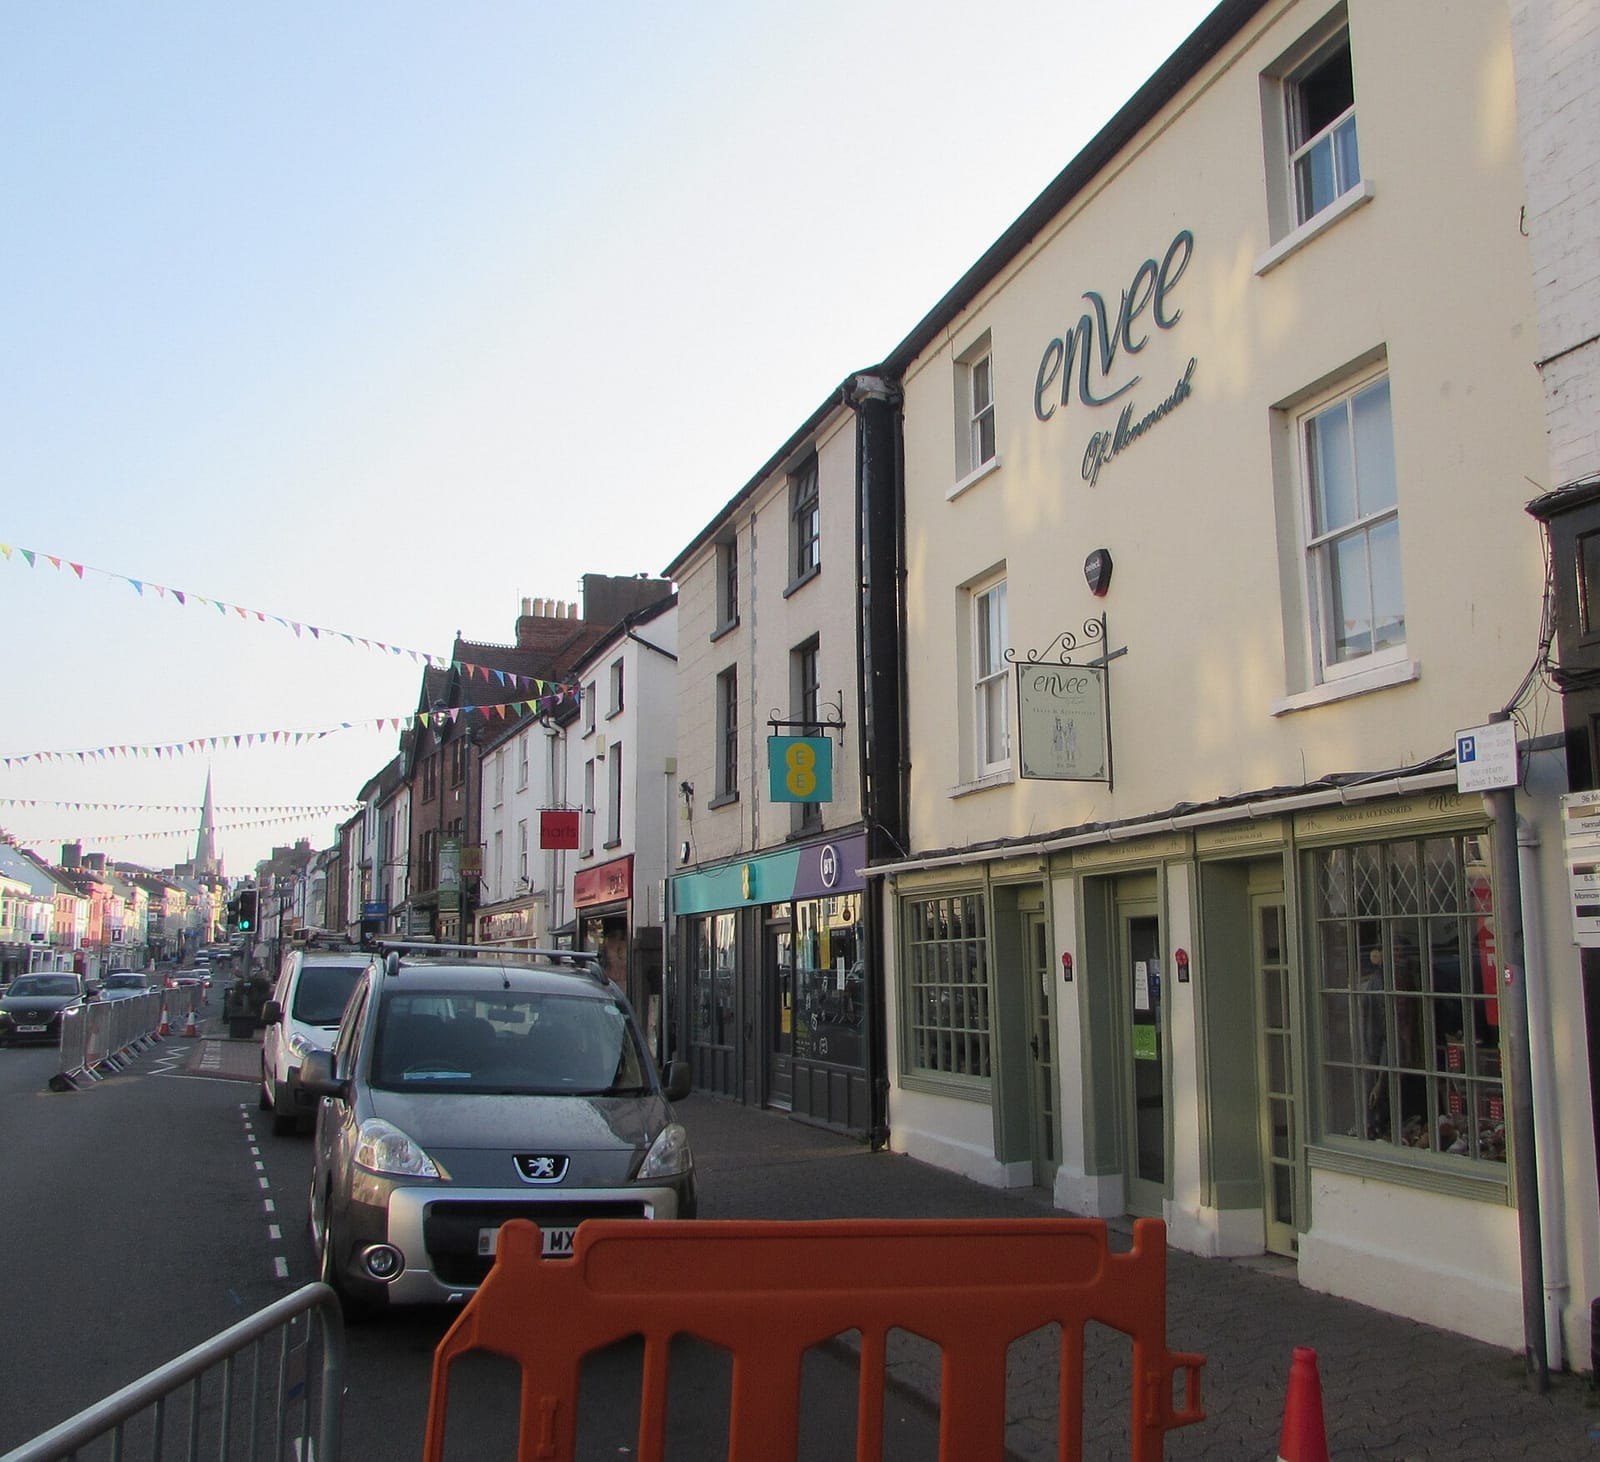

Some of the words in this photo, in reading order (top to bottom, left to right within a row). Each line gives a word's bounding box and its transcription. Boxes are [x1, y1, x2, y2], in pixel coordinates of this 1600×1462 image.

[1033, 229, 1194, 423] envee
[1103, 357, 1197, 463] Monmouth
[1033, 672, 1089, 699] envee
[1462, 740, 1473, 760] P
[1493, 775, 1509, 784] hour
[1366, 805, 1412, 818] ACCESSORIES
[1428, 793, 1464, 813] envee
[823, 855, 833, 874] BT
